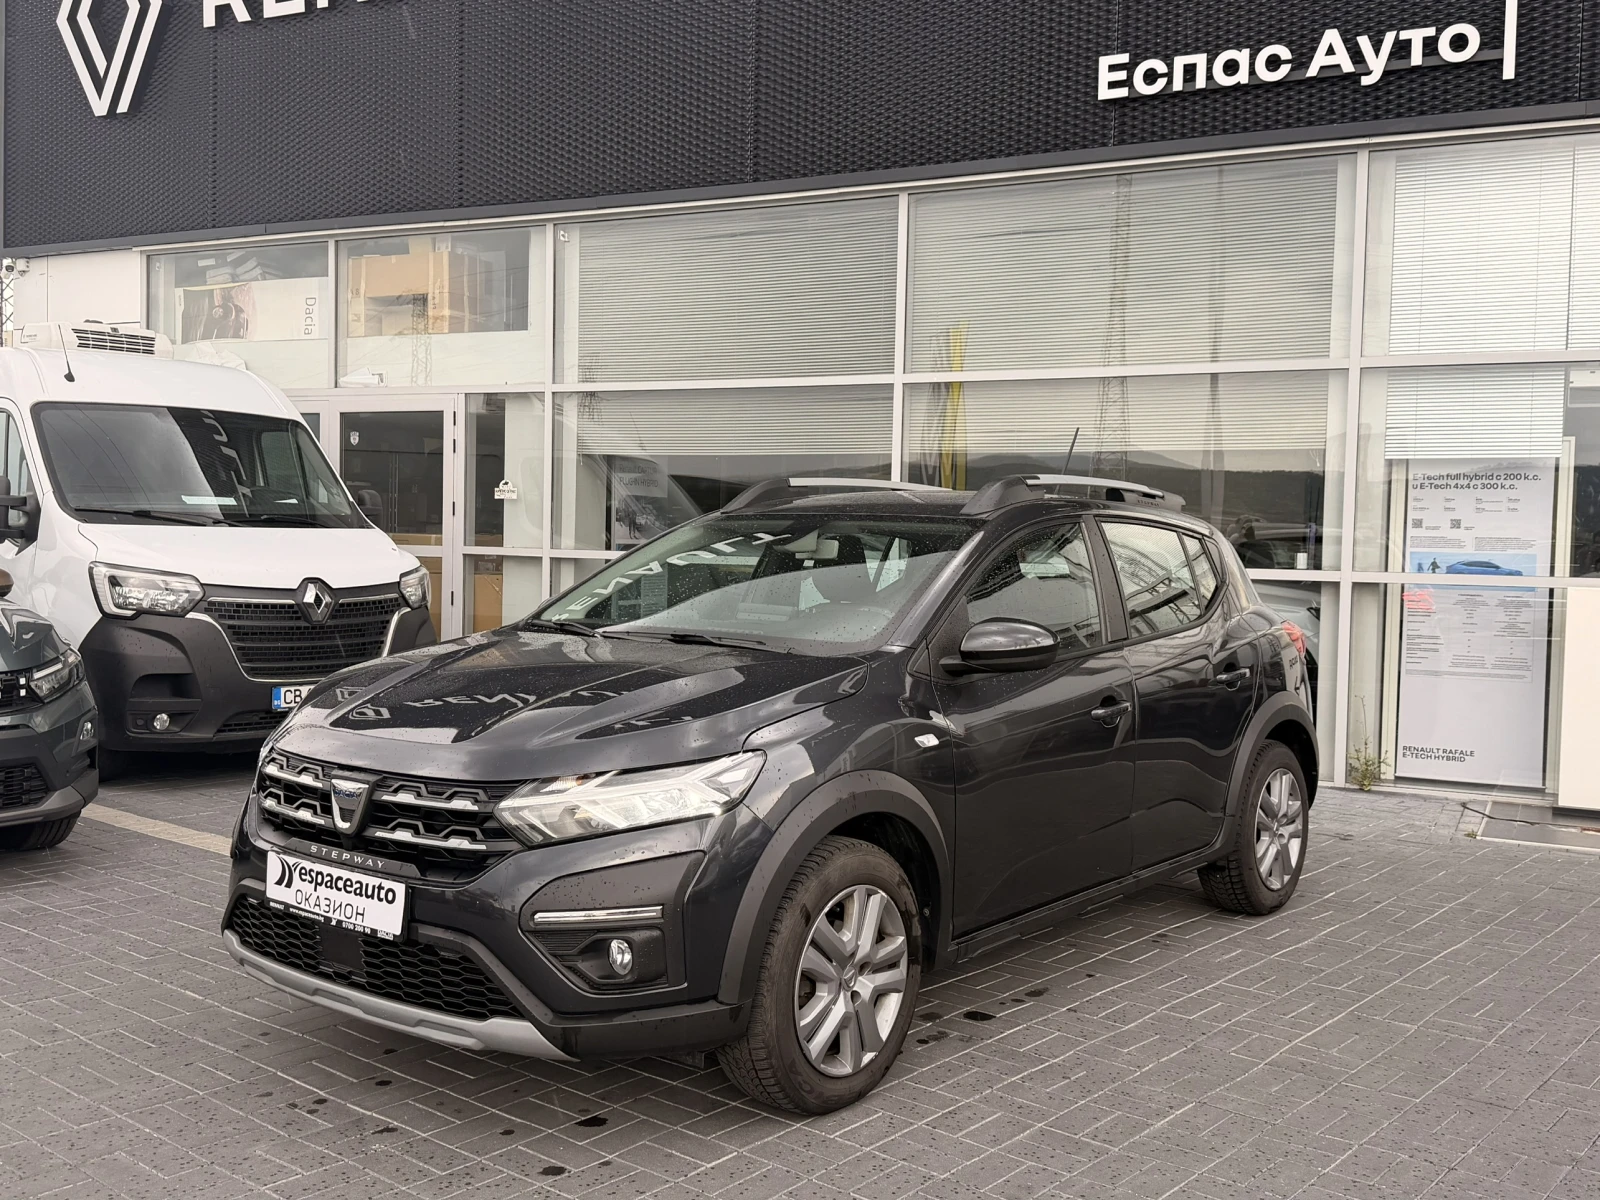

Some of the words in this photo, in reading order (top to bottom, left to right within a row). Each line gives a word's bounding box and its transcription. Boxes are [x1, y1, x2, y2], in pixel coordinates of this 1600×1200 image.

[1097, 43, 1293, 101] Еспас
[1305, 22, 1481, 86] Ауто
[304, 296, 316, 336] Dacia
[640, 478, 659, 488] HYBRID
[1412, 472, 1446, 481] E-Tech
[1446, 472, 1462, 481] full
[1462, 472, 1494, 483] hybrid
[1503, 473, 1523, 481] 200
[1419, 482, 1452, 490] E-Tech
[1453, 482, 1471, 490] 4x4
[1480, 482, 1499, 490] 300
[1402, 745, 1441, 755] RENAULT
[1442, 748, 1475, 757] RAFALE
[1402, 751, 1433, 760] E-TECH
[1433, 754, 1466, 763] HYBRID
[310, 845, 386, 869] STEPWAY
[298, 865, 397, 905] espaceauto
[294, 889, 366, 924] ОКАЗИОН
